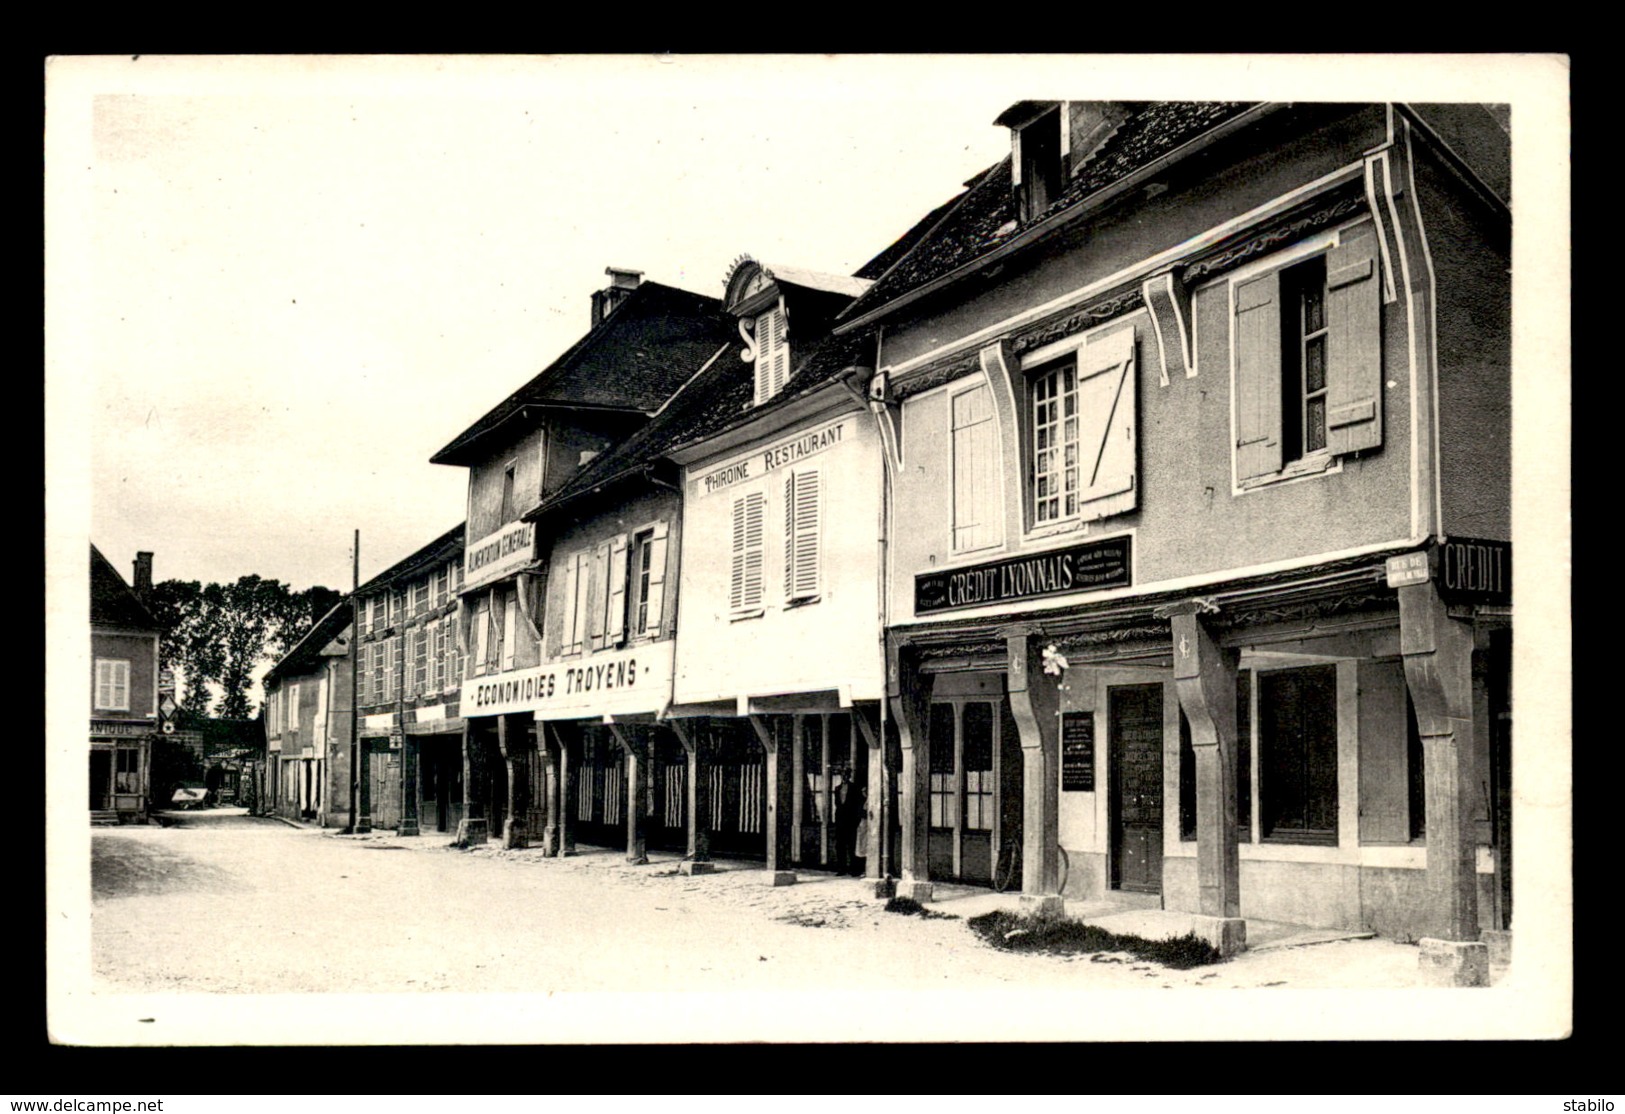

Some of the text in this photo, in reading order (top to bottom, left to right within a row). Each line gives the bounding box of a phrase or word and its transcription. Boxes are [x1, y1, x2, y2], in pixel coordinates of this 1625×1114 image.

[705, 424, 844, 493] THIROINE RESTAURANT
[948, 554, 1073, 606] CRÉDIT LYONNAIS
[1445, 538, 1503, 593] CRÉDIT
[566, 658, 637, 695] TROYENS
